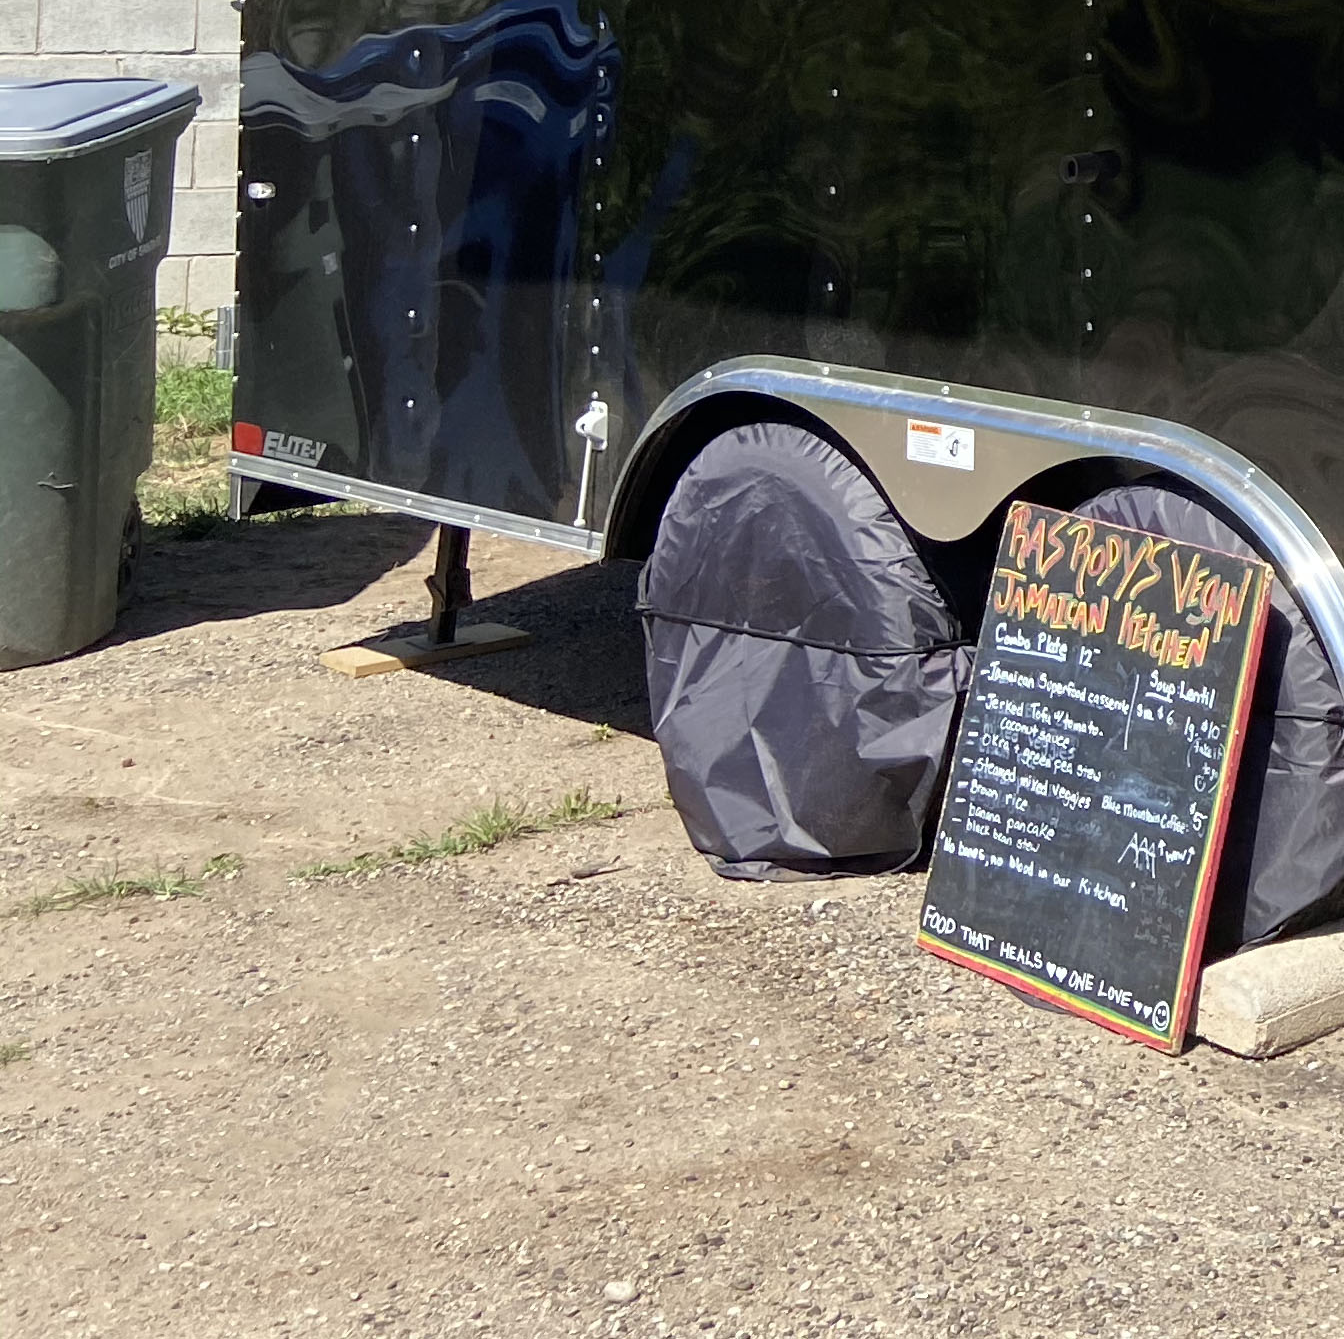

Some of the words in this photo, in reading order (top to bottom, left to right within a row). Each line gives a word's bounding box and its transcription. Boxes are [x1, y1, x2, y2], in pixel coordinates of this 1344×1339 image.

[1008, 507, 1070, 579] RAS
[1171, 550, 1254, 643] VEGAN
[994, 568, 1109, 637] JAMAICAN
[995, 622, 1031, 651] Combo
[1037, 630, 1068, 660] Plate
[968, 802, 1001, 825] banana
[1005, 792, 1029, 812] rice
[1101, 794, 1121, 815] Blue
[1009, 856, 1034, 877] blood
[1038, 868, 1048, 880] in
[922, 904, 957, 935] FOOD
[960, 924, 995, 952] THAT
[1000, 941, 1043, 970] HEALS
[1068, 971, 1094, 992] ONE
[1098, 978, 1133, 1007] LOVE
